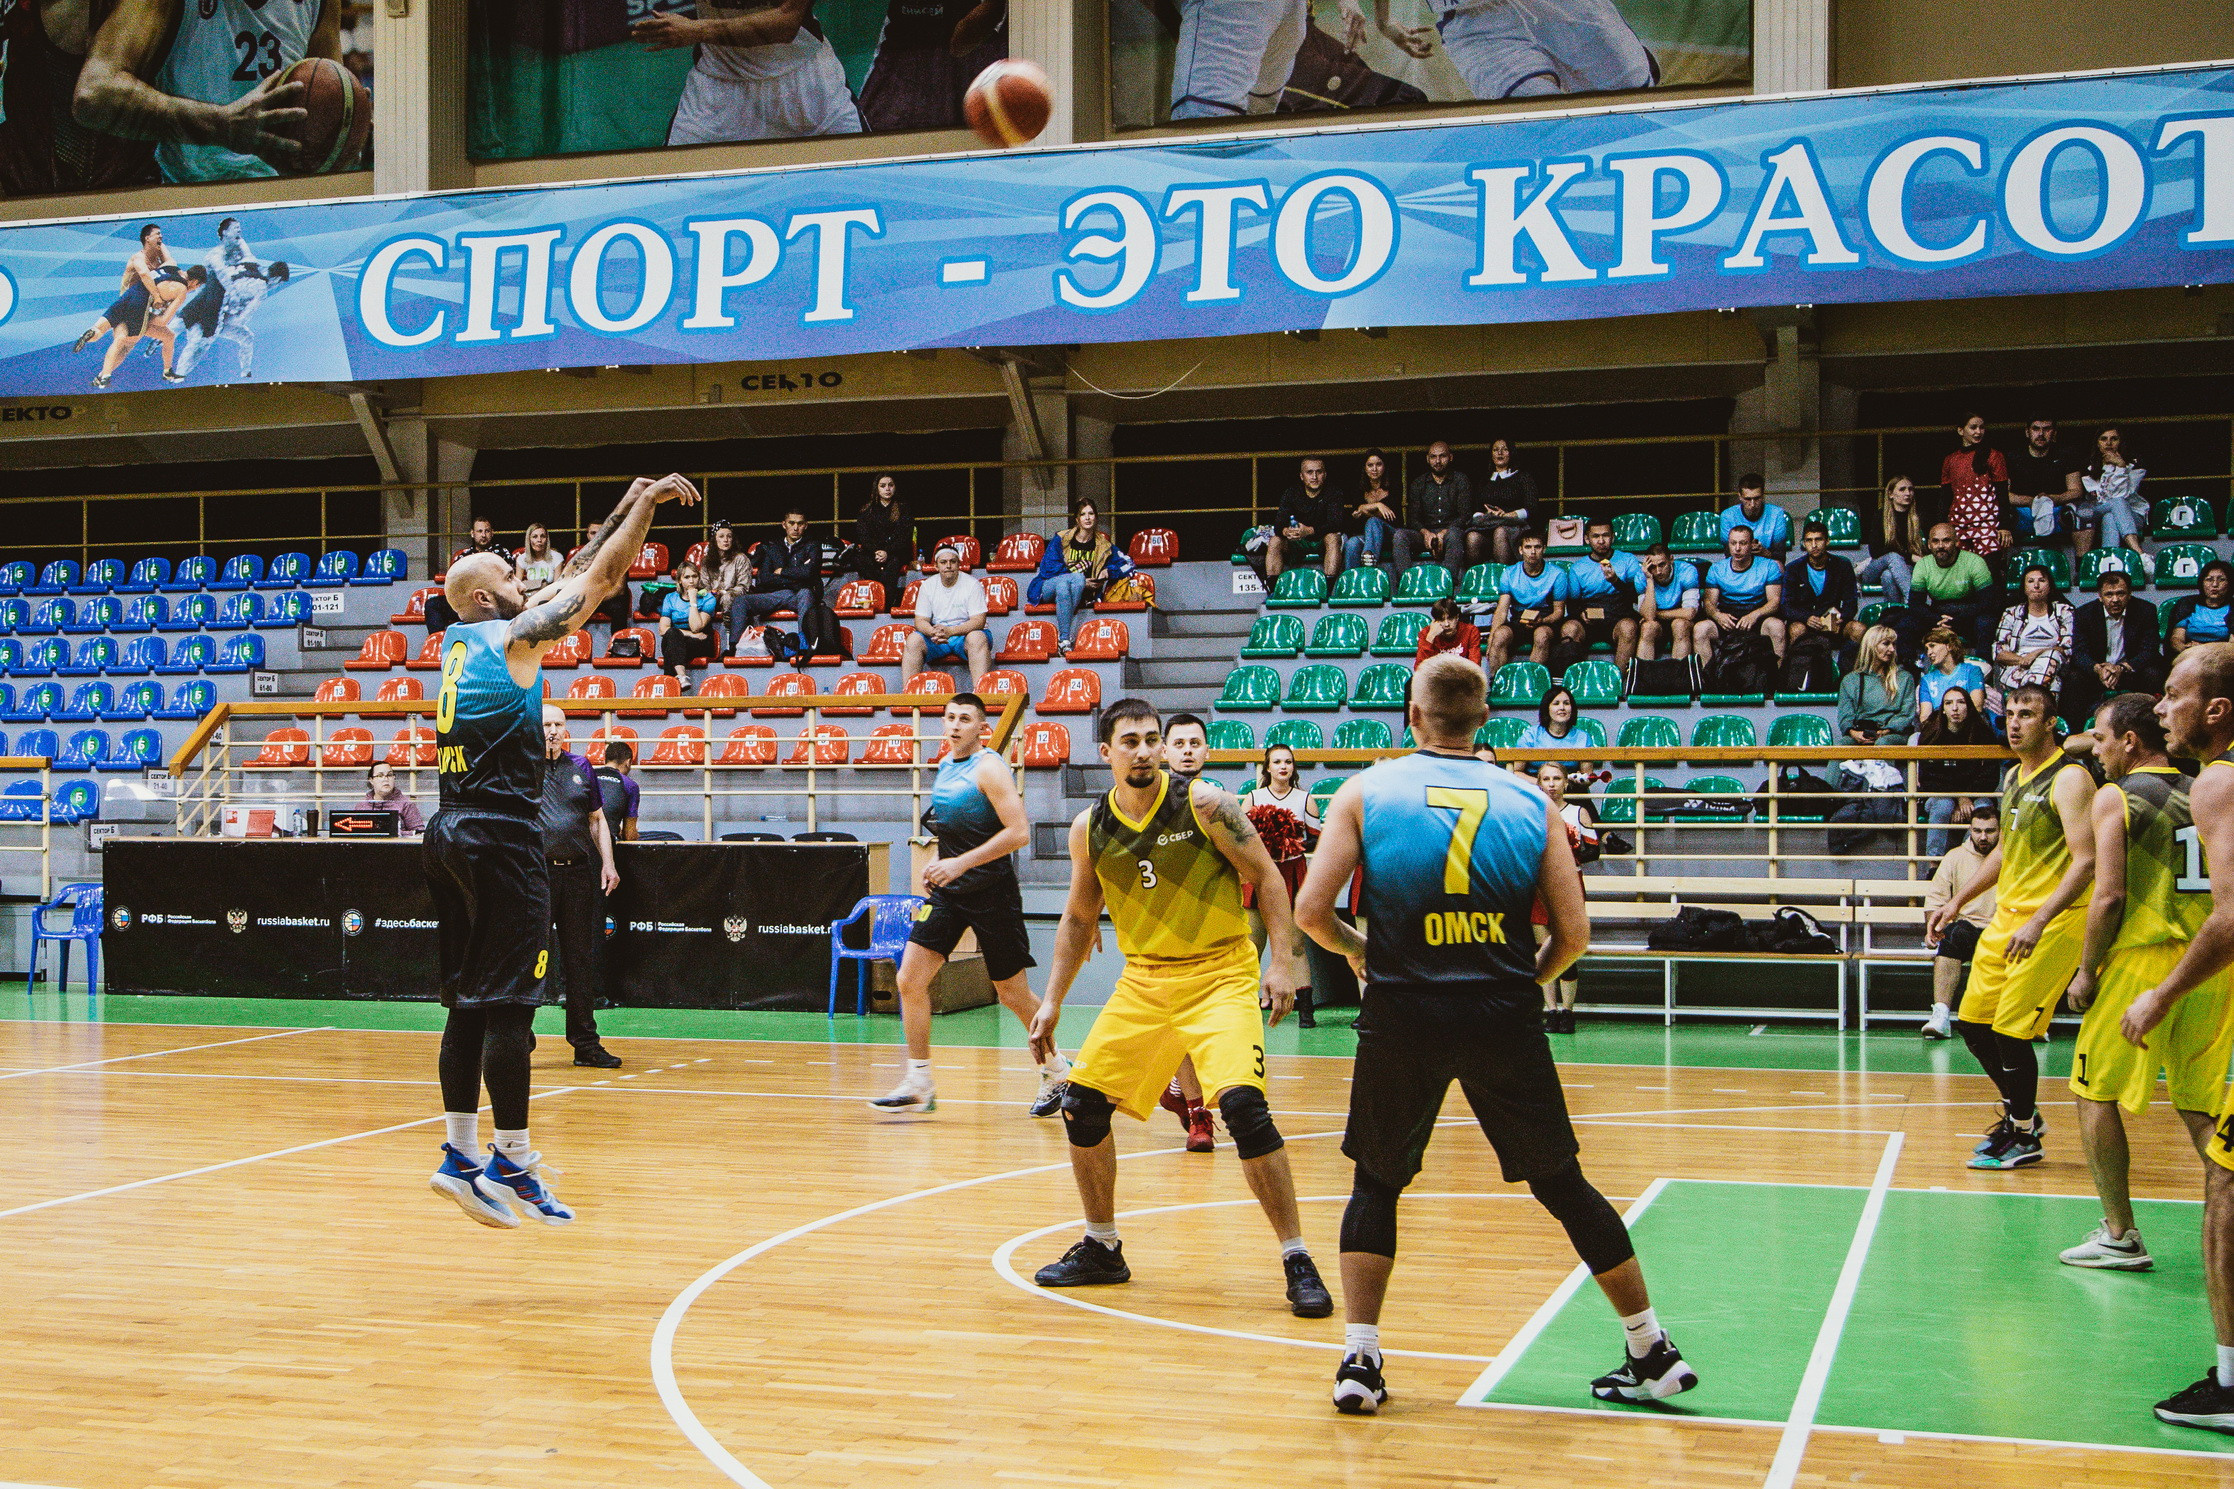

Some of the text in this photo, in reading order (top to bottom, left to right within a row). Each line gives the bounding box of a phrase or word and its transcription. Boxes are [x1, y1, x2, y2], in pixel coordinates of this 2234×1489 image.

[231, 31, 283, 82] 23
[357, 208, 883, 348] СПОРТ
[942, 260, 985, 284] -
[1060, 175, 1395, 310] ЭТО
[894, 633, 904, 642] 33
[1031, 630, 1040, 639] 35
[1101, 628, 1110, 636] 36
[568, 637, 577, 646] 28
[437, 641, 468, 734] 8
[590, 686, 599, 694] 17
[655, 686, 663, 694] 18
[787, 684, 797, 692] 20
[858, 682, 867, 692] 21
[926, 681, 936, 690] 22
[999, 680, 1009, 689] 23
[1071, 681, 1082, 690] 24
[1038, 732, 1048, 741] 12
[2010, 808, 2019, 831] 7
[1168, 830, 1194, 843] СБЕР
[1424, 784, 1489, 895] 7
[1137, 858, 1159, 890] 3
[141, 913, 164, 924] РФБ
[257, 916, 331, 927] russiabasket.ru
[374, 918, 440, 929] #здесьбаске
[629, 921, 654, 932] РФБ
[758, 923, 832, 934] russiabasket.r
[1423, 911, 1507, 946] ОМСК
[534, 949, 549, 979] 8
[2030, 1007, 2045, 1031] 7
[1252, 1044, 1265, 1079] 3
[2077, 1053, 2089, 1087] 1
